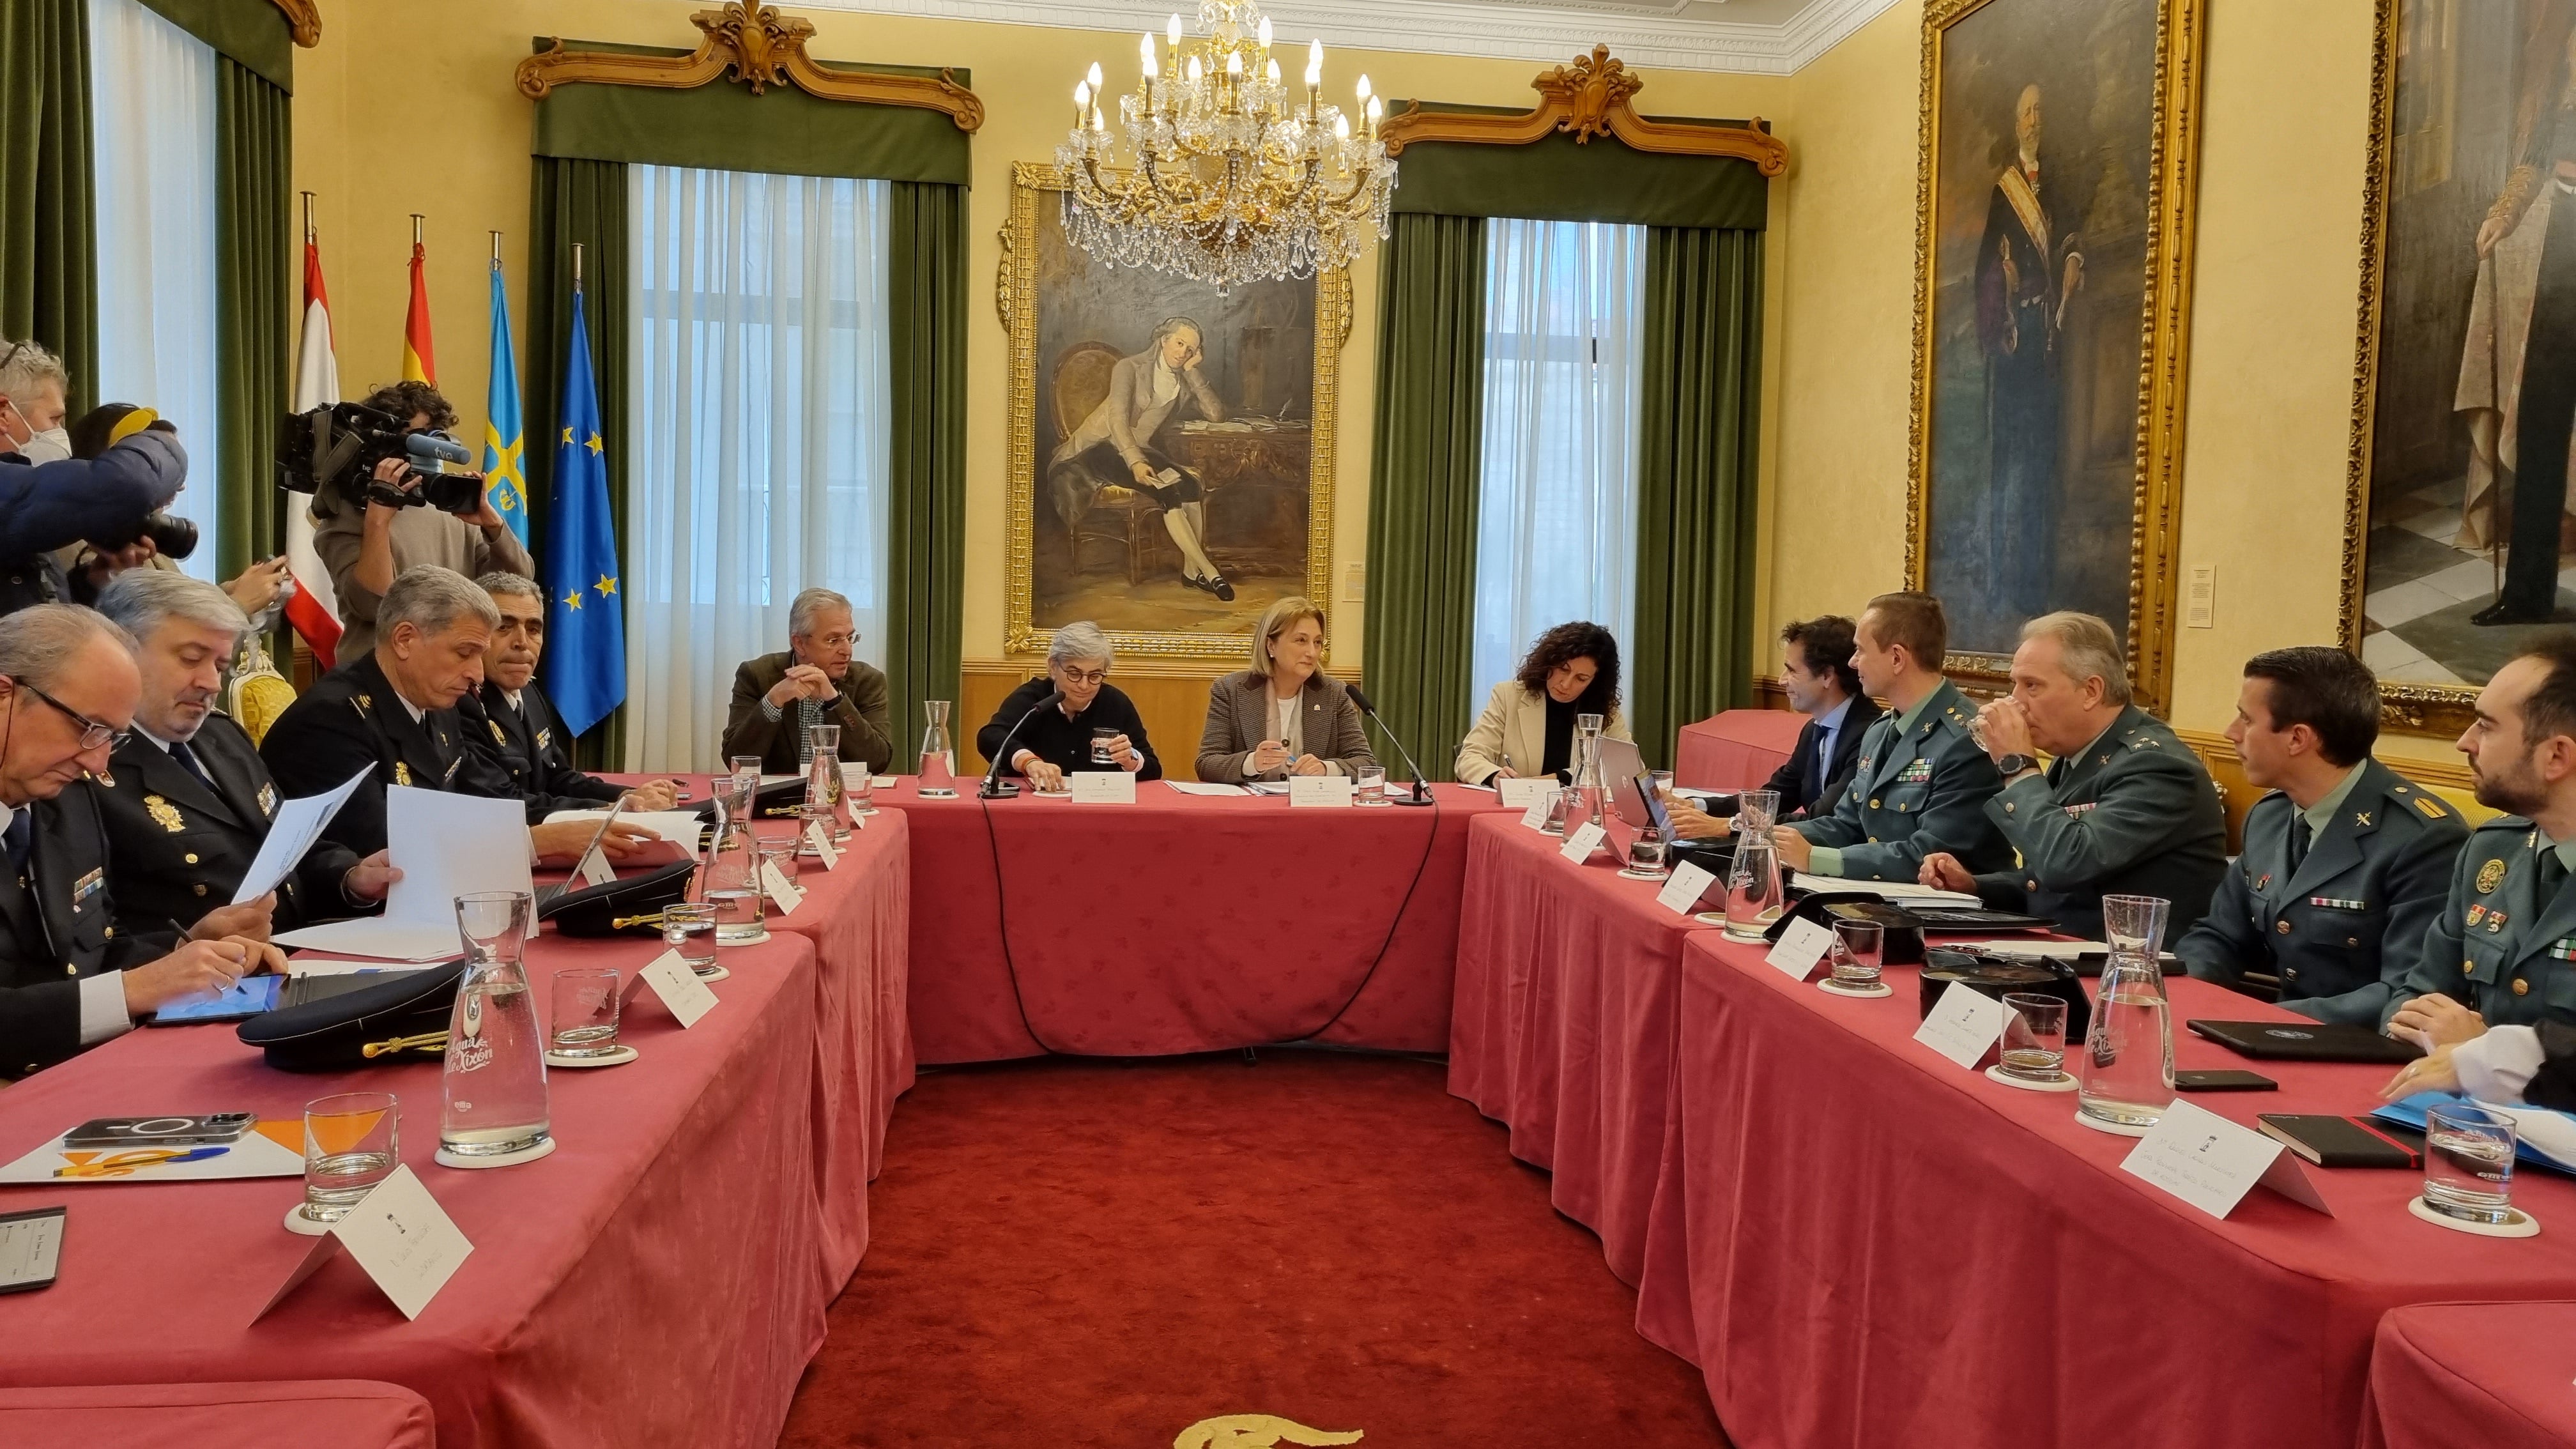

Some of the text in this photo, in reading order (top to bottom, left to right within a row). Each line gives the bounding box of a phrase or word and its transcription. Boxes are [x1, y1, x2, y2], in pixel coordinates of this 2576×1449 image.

[434, 447, 454, 460] tve
[448, 1037, 476, 1058] Agua
[456, 1048, 493, 1071] Xixón
